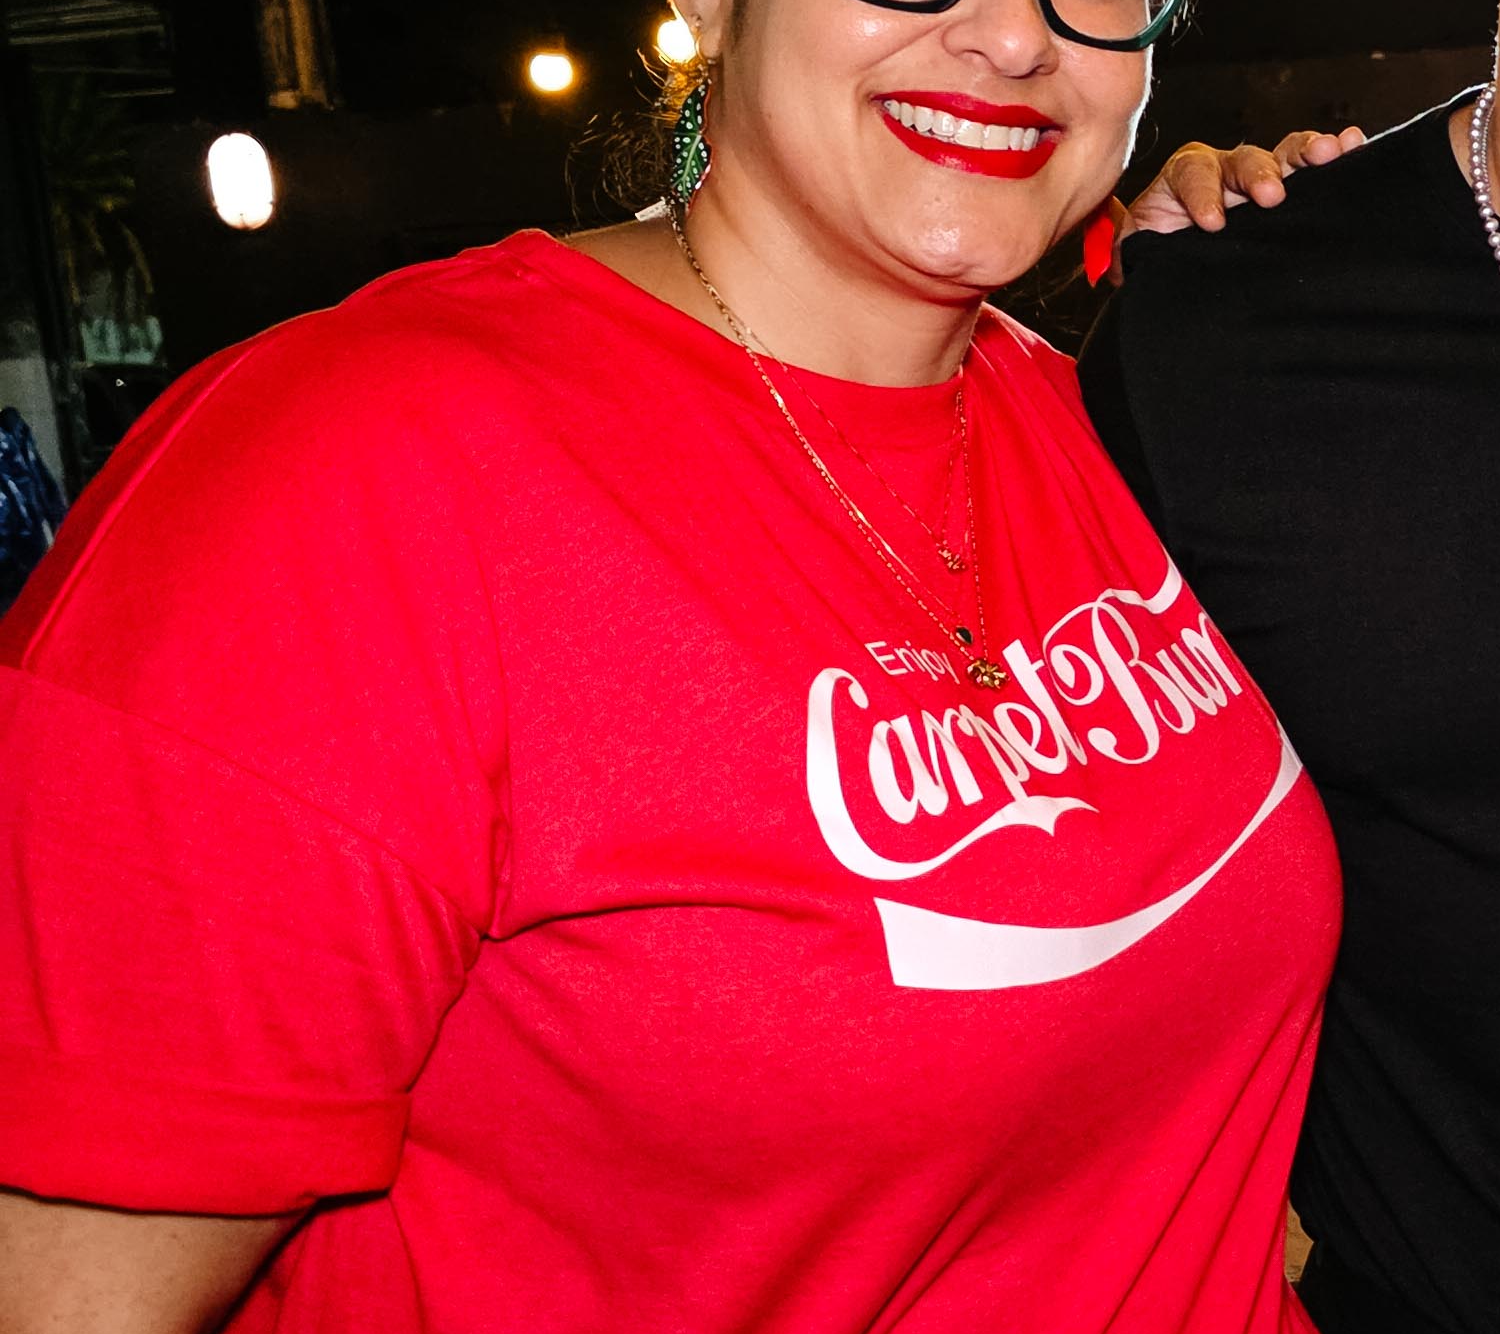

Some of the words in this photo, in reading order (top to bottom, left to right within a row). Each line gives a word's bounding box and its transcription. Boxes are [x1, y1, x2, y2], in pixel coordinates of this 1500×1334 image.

[806, 639, 1099, 881] Carpet
[1042, 547, 1244, 765] Bur
[864, 639, 960, 685] Enjoy
